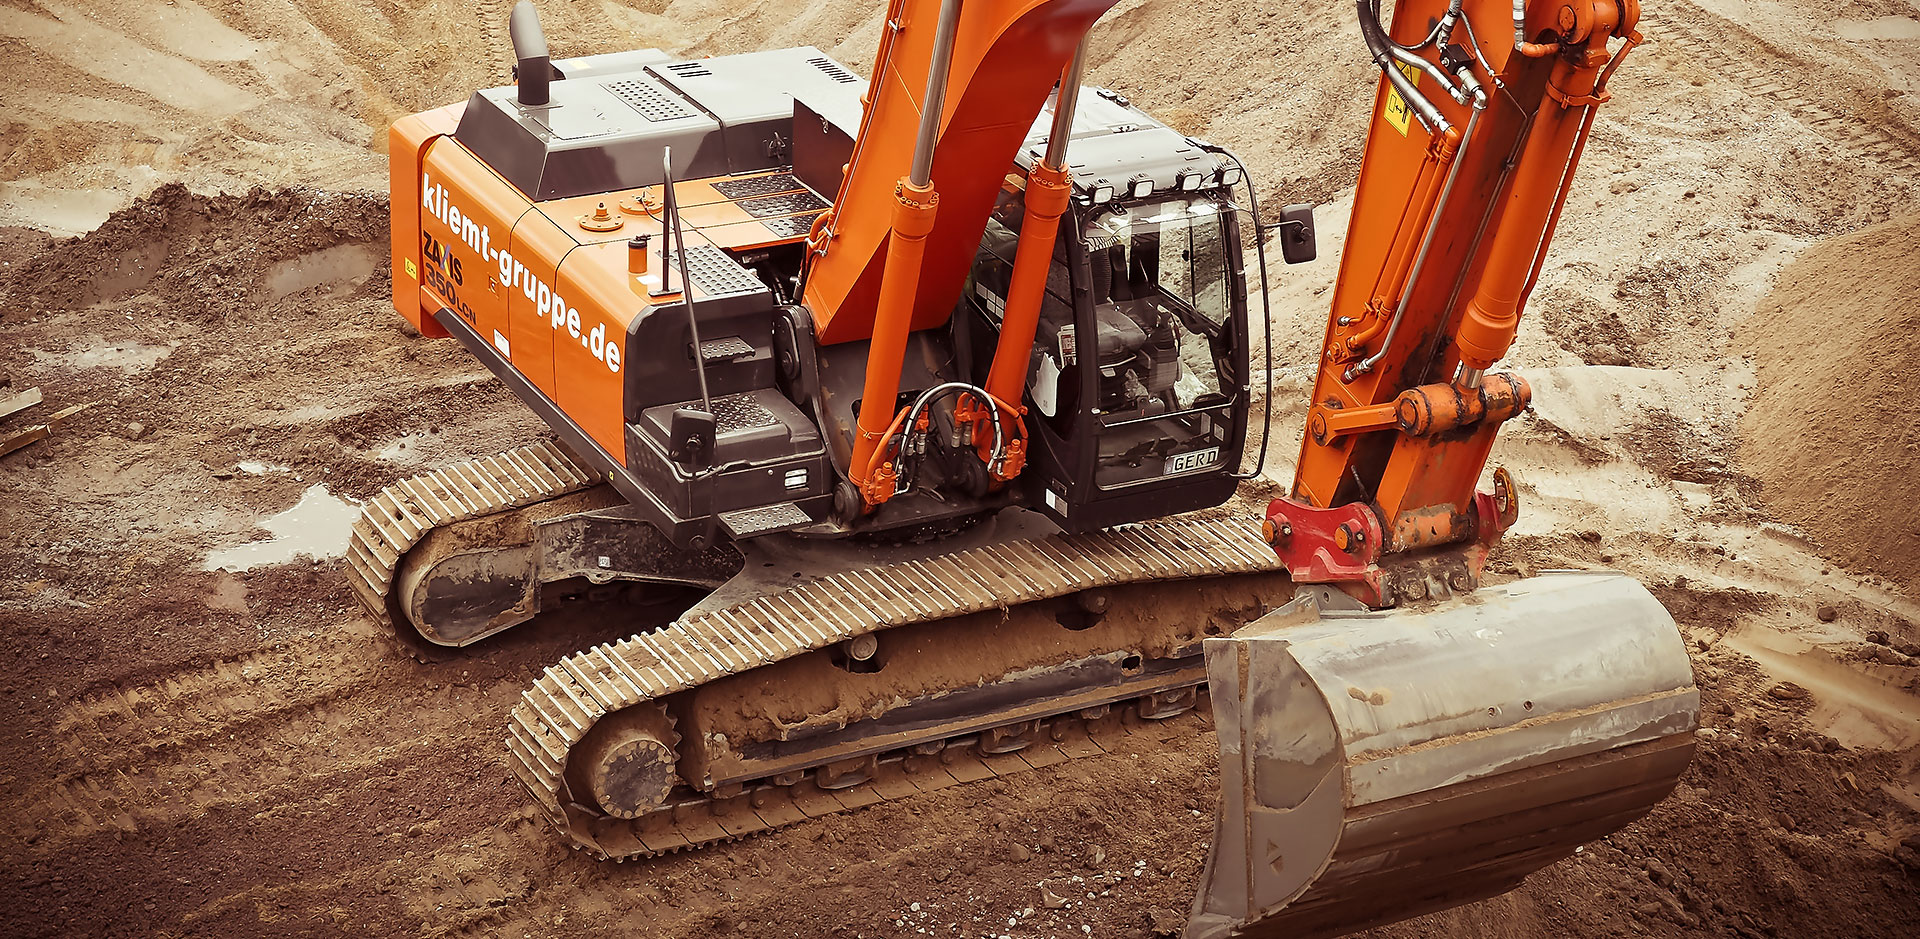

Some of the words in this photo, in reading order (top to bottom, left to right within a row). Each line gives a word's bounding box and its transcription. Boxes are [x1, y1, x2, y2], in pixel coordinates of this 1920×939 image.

[423, 229, 463, 286] ZAXIS
[423, 172, 621, 373] kliemt-gruppe.de
[1174, 451, 1217, 471] GERD
